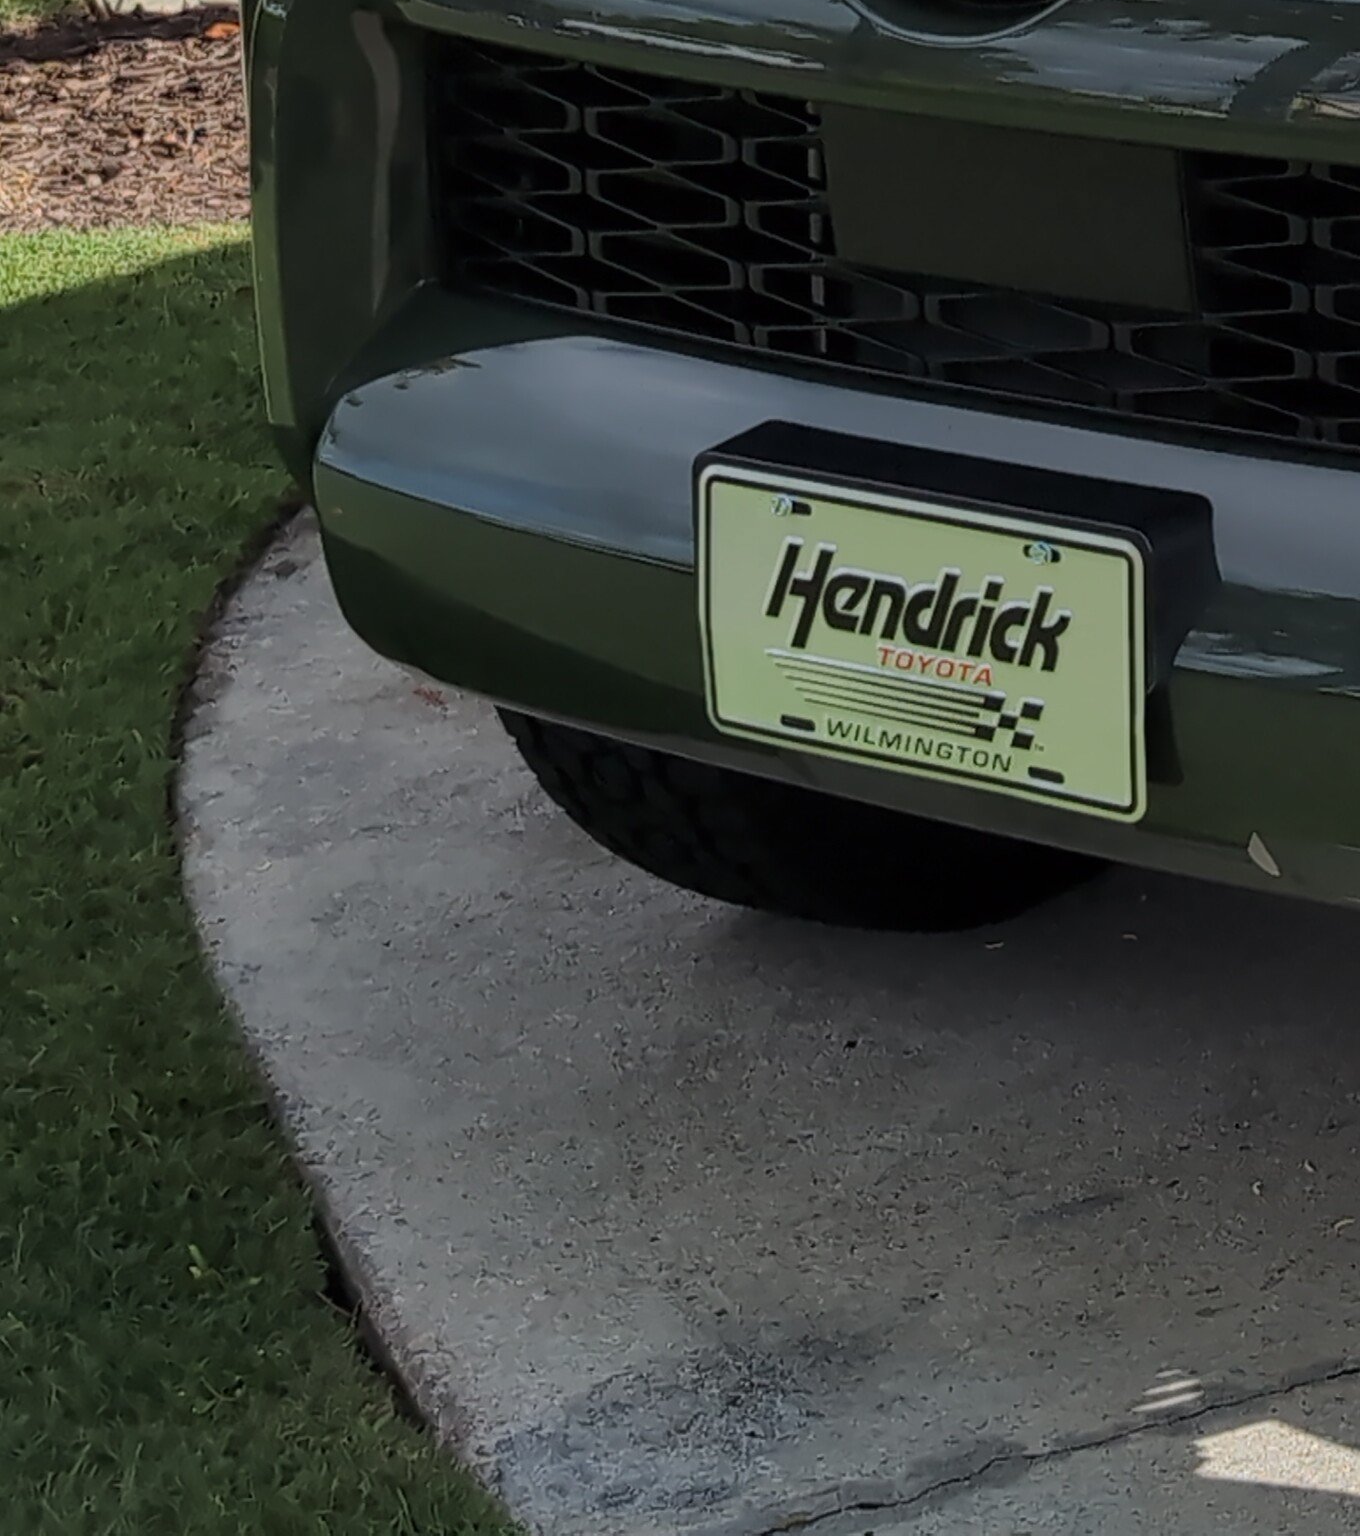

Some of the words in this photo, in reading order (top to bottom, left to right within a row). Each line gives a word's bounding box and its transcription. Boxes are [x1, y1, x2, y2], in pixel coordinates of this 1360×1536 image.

[764, 536, 1072, 672] Hendrick
[878, 646, 993, 687] TOYOTA
[825, 716, 1014, 774] WILMINGTON
